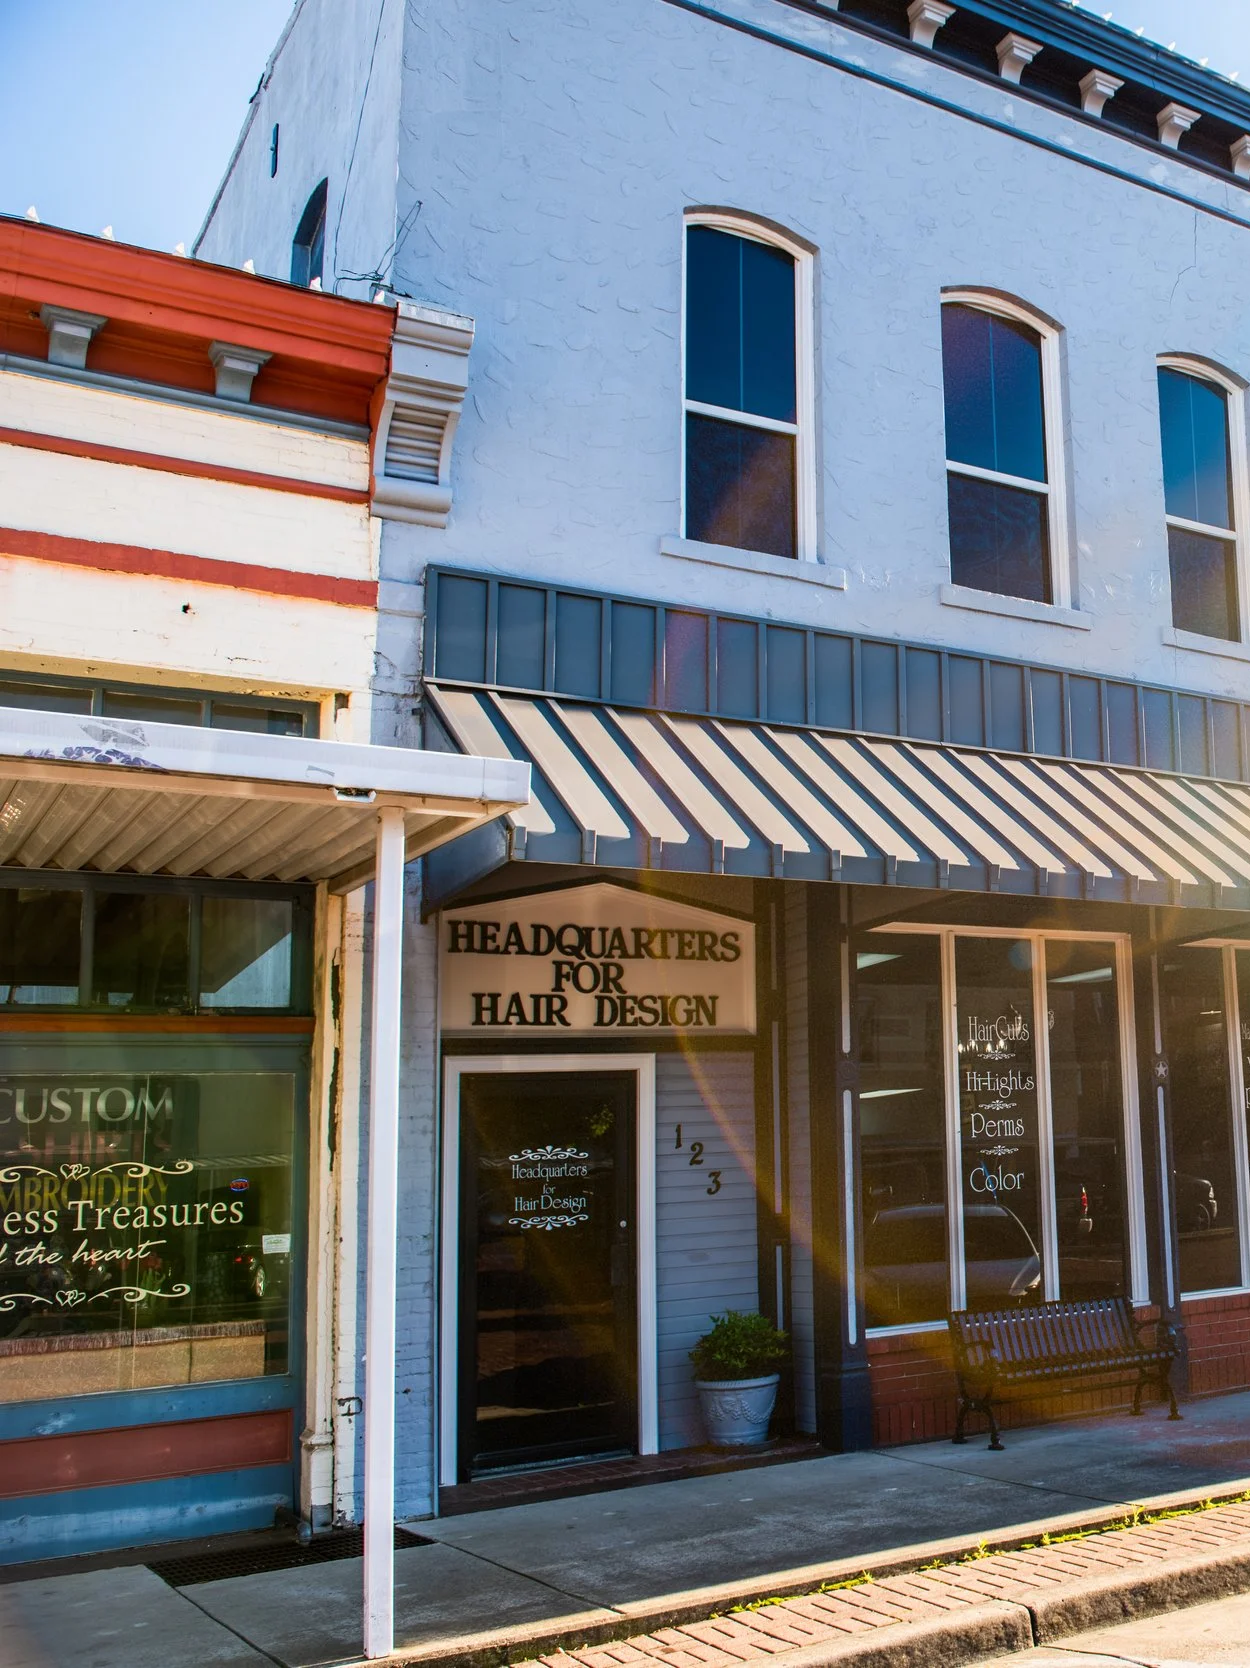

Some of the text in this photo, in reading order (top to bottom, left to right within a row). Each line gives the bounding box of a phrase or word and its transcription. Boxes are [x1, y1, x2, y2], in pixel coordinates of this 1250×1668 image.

[447, 920, 741, 962] HEADQUARTERS
[551, 960, 627, 994] FOR
[471, 992, 719, 1027] HAIR DESIGN
[966, 1069, 1035, 1098] Hi-Lights
[970, 1112, 1025, 1138] Perms
[512, 1163, 588, 1182] Headquarters
[969, 1165, 1025, 1193] Color
[67, 1200, 245, 1232] Treasures
[514, 1194, 587, 1214] Hair Design
[15, 1240, 63, 1266] the
[72, 1238, 167, 1263] heart
